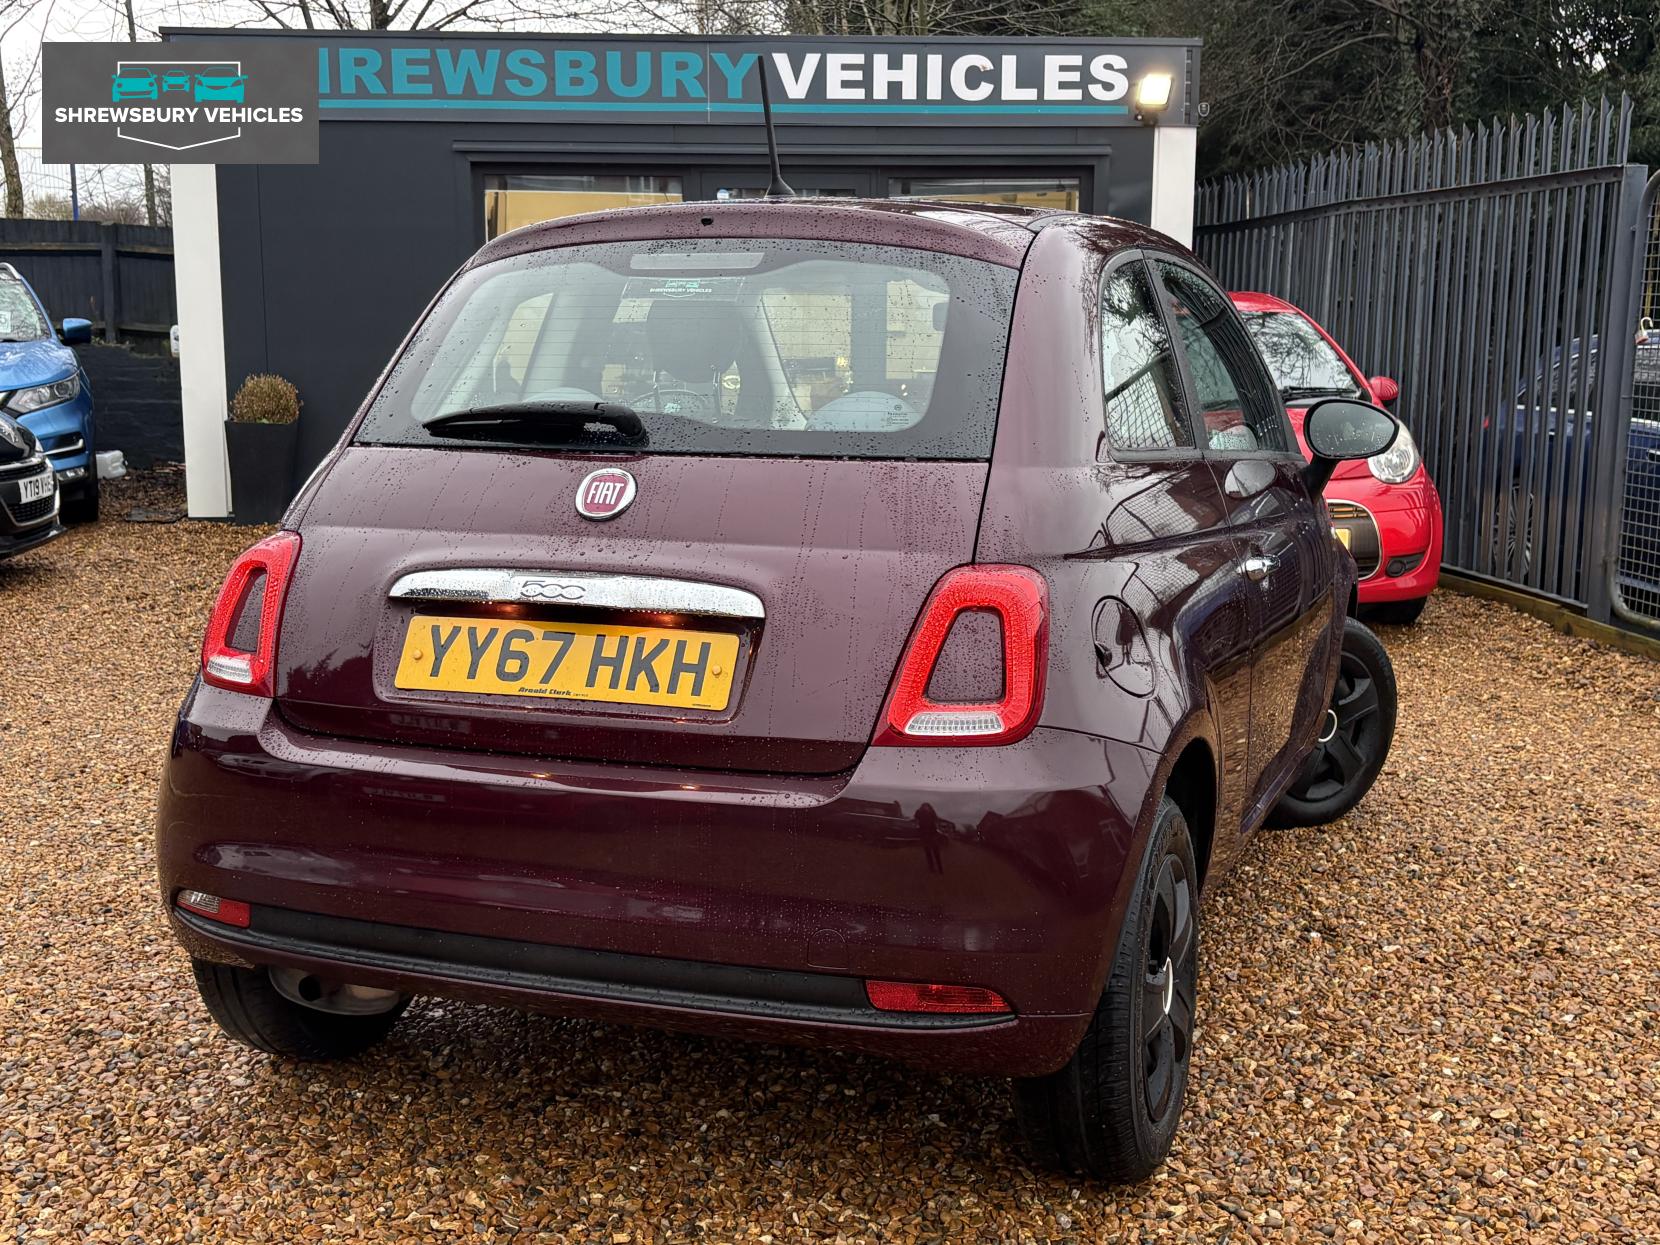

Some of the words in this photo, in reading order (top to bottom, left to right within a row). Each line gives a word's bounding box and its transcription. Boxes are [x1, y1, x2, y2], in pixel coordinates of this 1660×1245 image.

[319, 47, 759, 99] REWSBURY
[771, 53, 1129, 101] VEHICLES
[586, 481, 624, 505] FIAT
[520, 580, 587, 600] 500
[429, 624, 577, 684] YY67
[585, 633, 712, 697] HKH
[518, 686, 547, 695] Arnold
